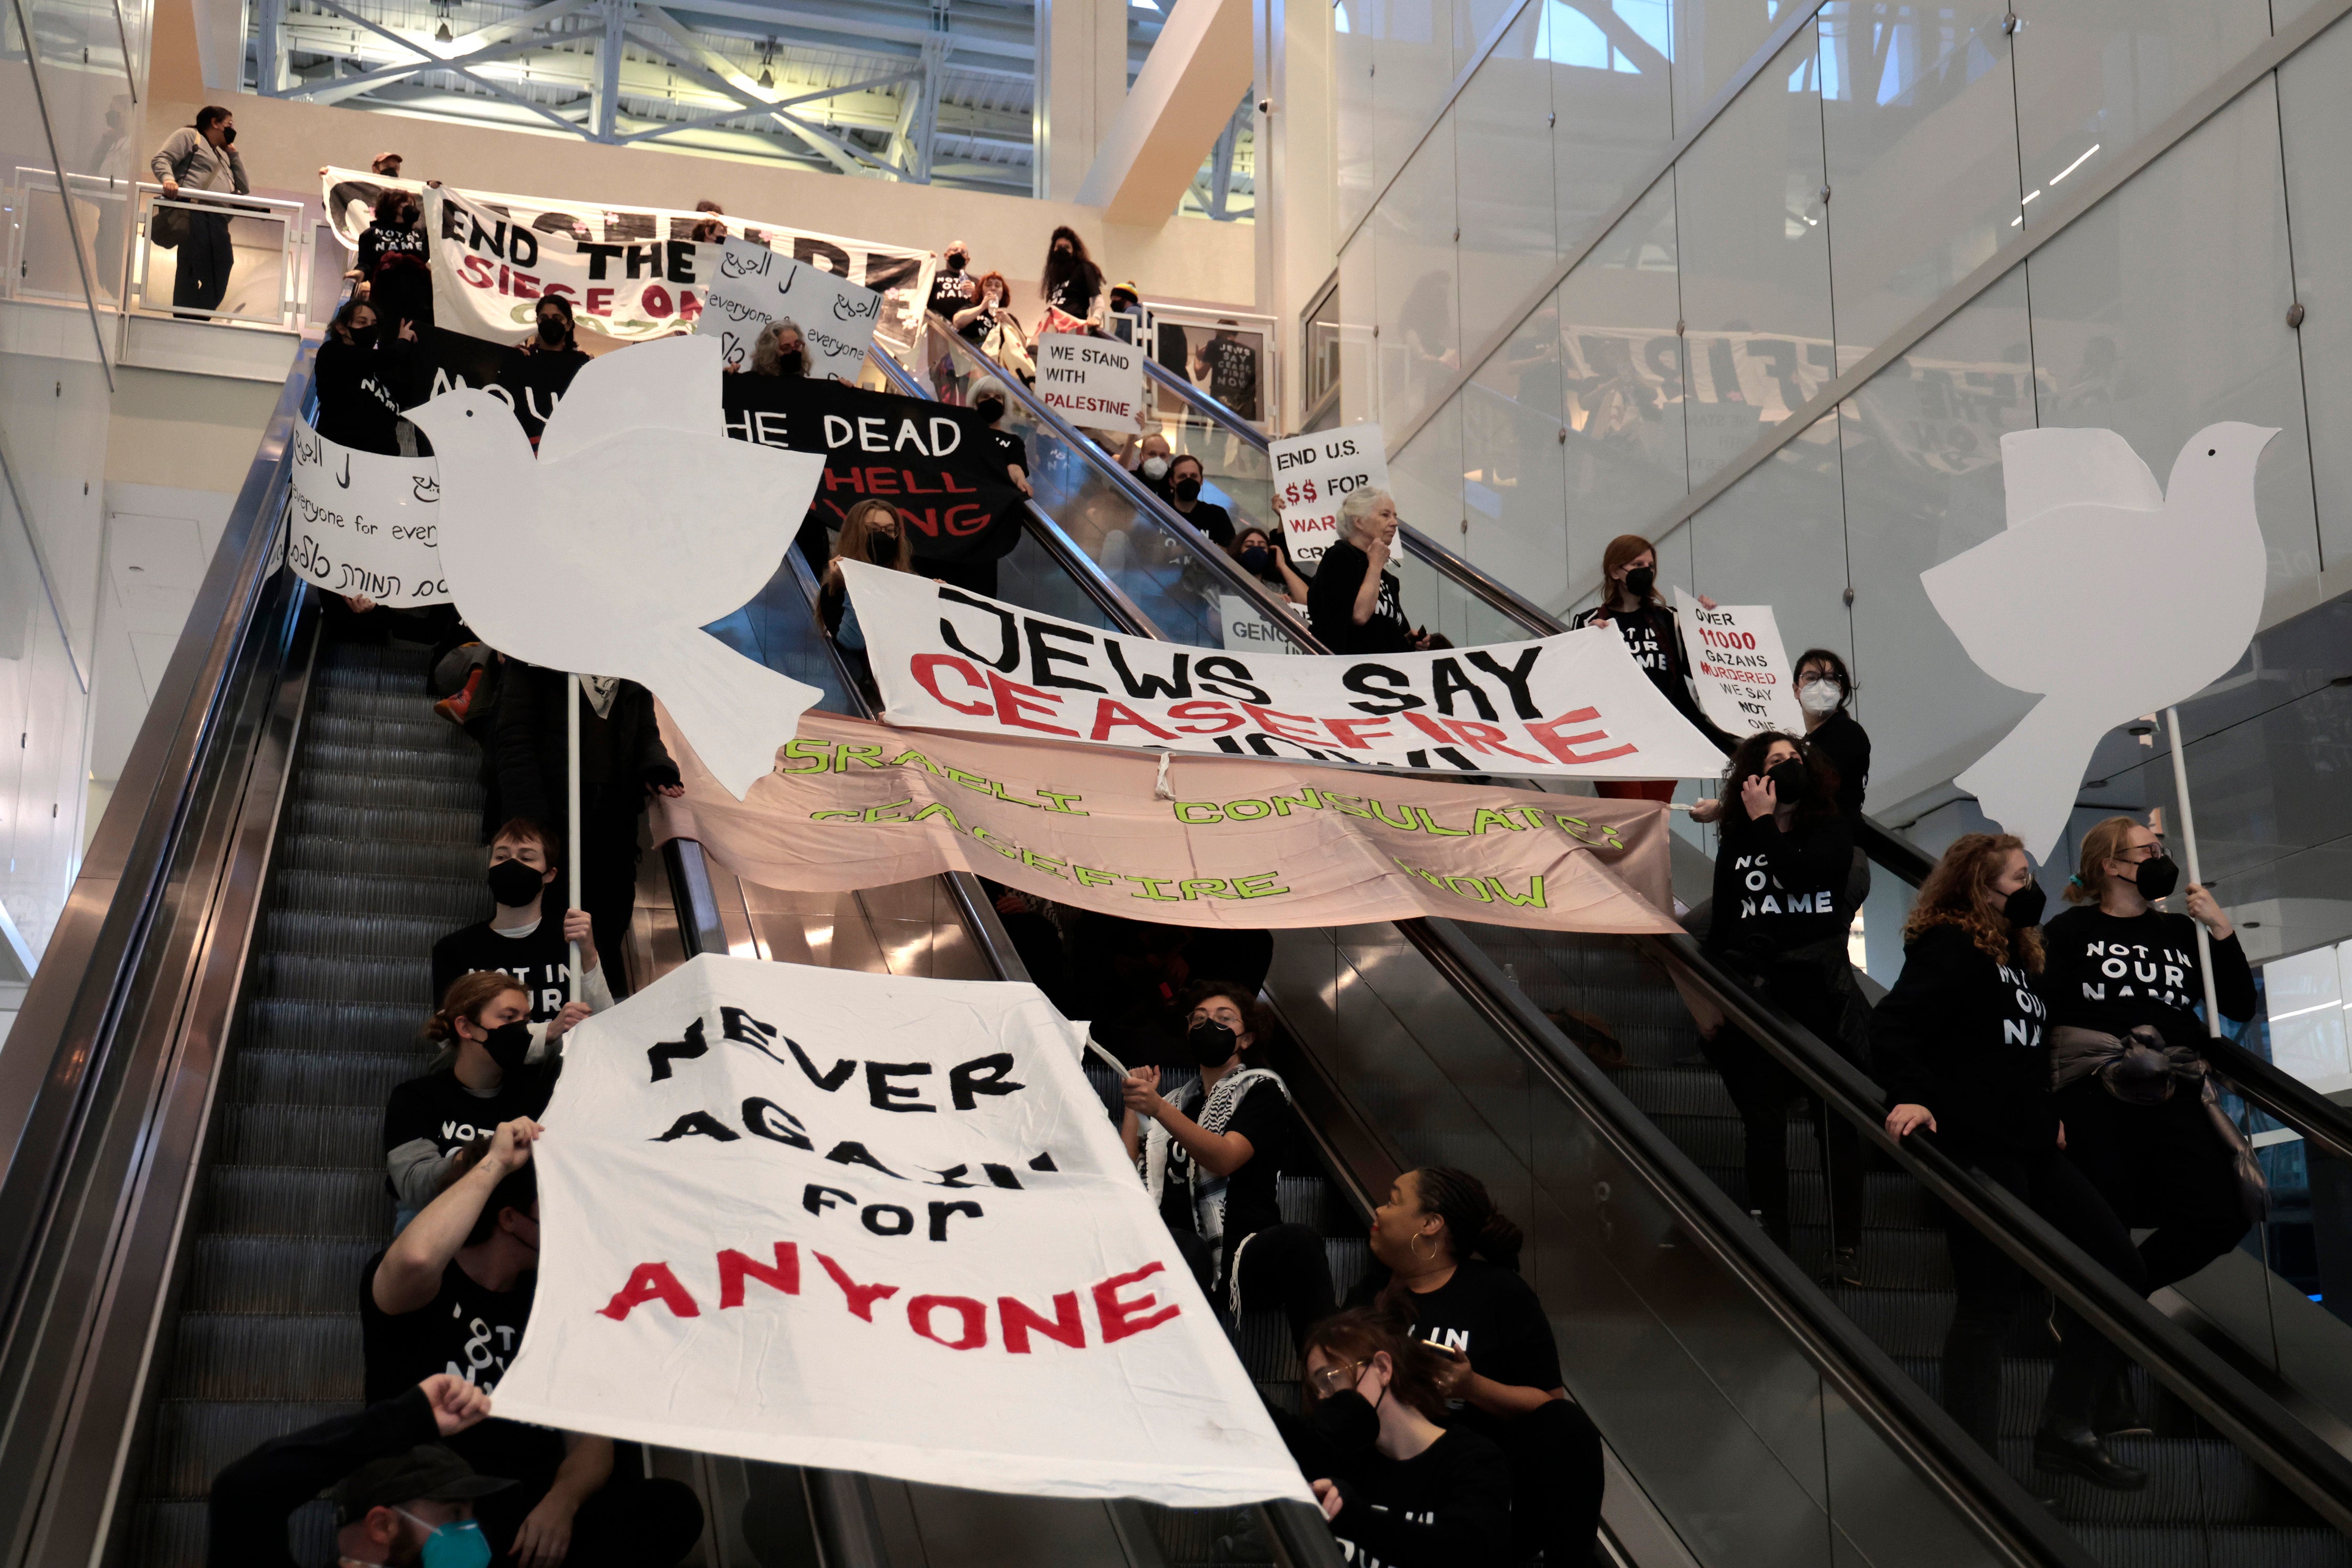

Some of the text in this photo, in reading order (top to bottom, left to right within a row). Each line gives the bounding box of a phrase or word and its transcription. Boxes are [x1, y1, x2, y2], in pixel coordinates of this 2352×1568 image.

[375, 228, 402, 237] NOT
[441, 198, 539, 269] END
[577, 240, 697, 284] THE
[375, 241, 422, 251] NAME
[642, 285, 708, 320] ON
[709, 294, 772, 324] everyone
[808, 329, 864, 360] everyone
[1219, 344, 1250, 356] JEWS
[1051, 346, 1129, 370] WE STAND
[1224, 352, 1247, 363] SAY
[1046, 367, 1085, 384] WITH
[1045, 393, 1130, 417] PALESTINE
[721, 409, 961, 457] HE DEAD
[1276, 439, 1359, 470] END U.S.
[824, 466, 977, 495] HELL
[1328, 474, 1369, 497] FOR
[293, 482, 345, 528] everyone
[354, 515, 378, 535] for
[1289, 515, 1336, 533] WAR
[1696, 608, 1735, 626] OVER
[1625, 641, 1659, 653] UR
[1699, 627, 1756, 650] 11000
[938, 586, 1543, 722] JEWS SAY
[1636, 653, 1667, 671] ME
[1705, 650, 1767, 667] GAZANS
[1700, 661, 1776, 684] MURDERED
[1720, 683, 1771, 700] WE SAY
[910, 653, 1639, 765] CEASEFIRE
[1738, 701, 1767, 717] NOT
[774, 739, 1091, 817] SRAELI
[1173, 787, 1624, 850] CONSULATE:
[808, 798, 1548, 909] CEASEFIRE NOW
[1735, 854, 1768, 870] NO
[1740, 891, 1833, 918] NAME
[2086, 941, 2193, 967] NOT IN
[2102, 958, 2184, 988] OUR
[647, 1006, 1026, 1113] NEVER
[595, 1241, 1184, 1355] ANYONE
